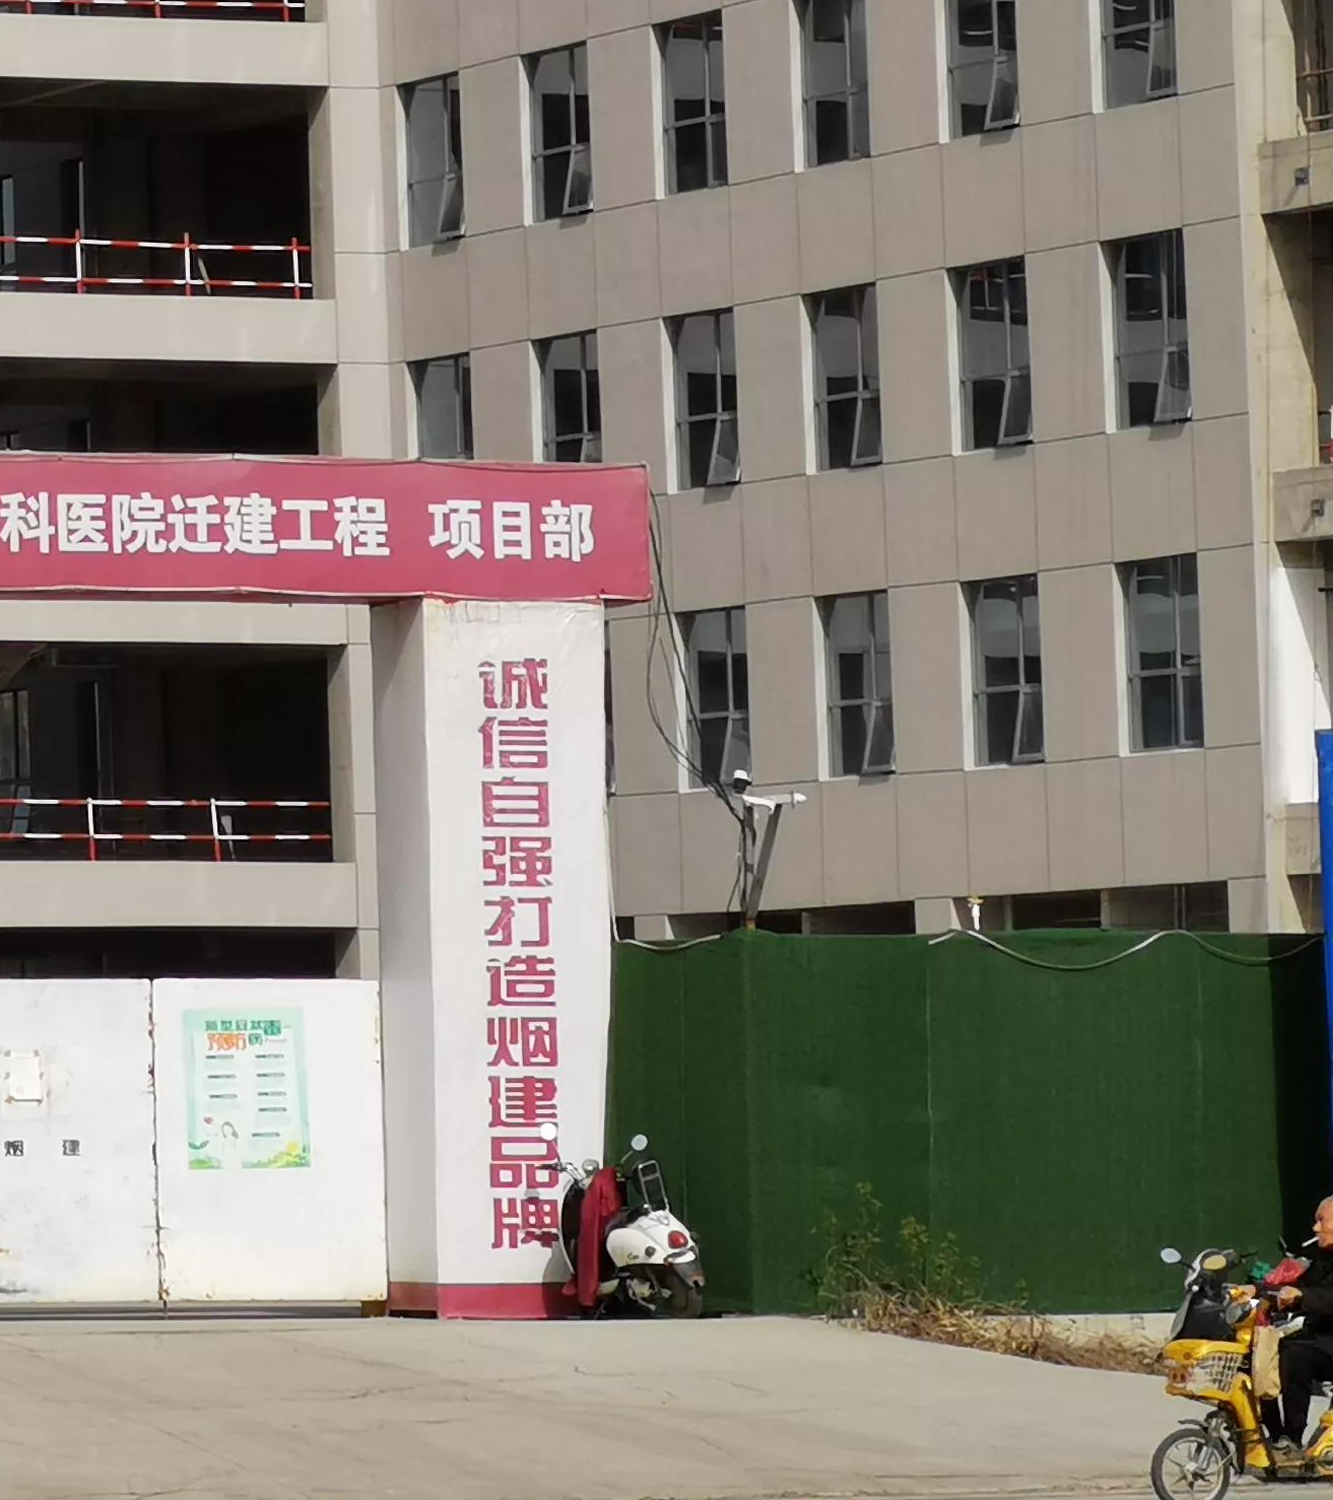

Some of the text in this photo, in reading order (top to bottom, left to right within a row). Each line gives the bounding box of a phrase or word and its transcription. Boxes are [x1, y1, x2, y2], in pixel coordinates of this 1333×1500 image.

[427, 499, 595, 563] 项目部
[478, 658, 561, 1249] 诚信自强打造烟建品牌
